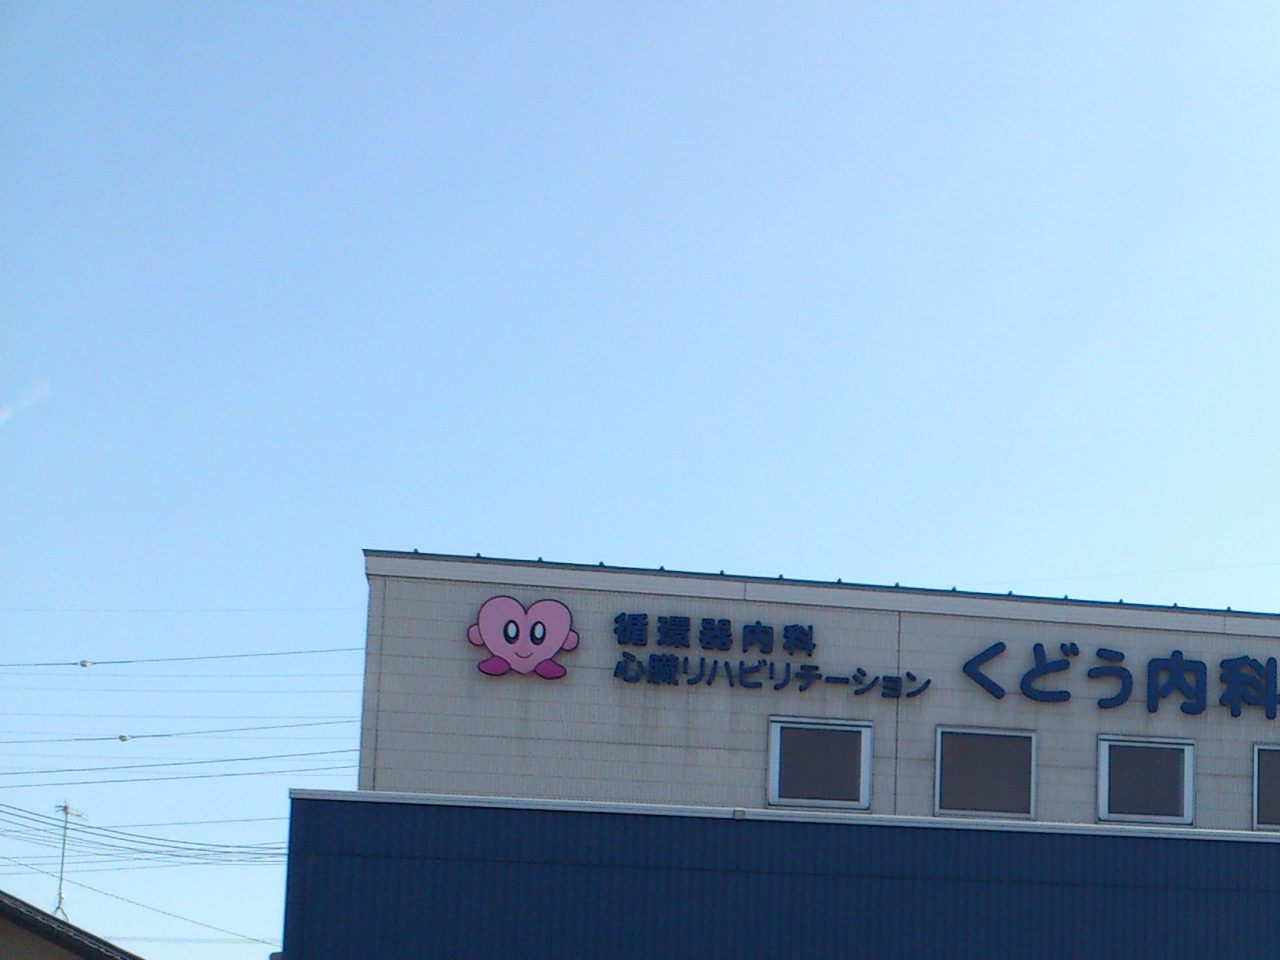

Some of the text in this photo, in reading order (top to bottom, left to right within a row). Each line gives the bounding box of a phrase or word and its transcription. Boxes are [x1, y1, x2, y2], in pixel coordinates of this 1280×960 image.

[614, 612, 816, 656] 循環器内科
[613, 652, 931, 698] 心臓リハビリテーション
